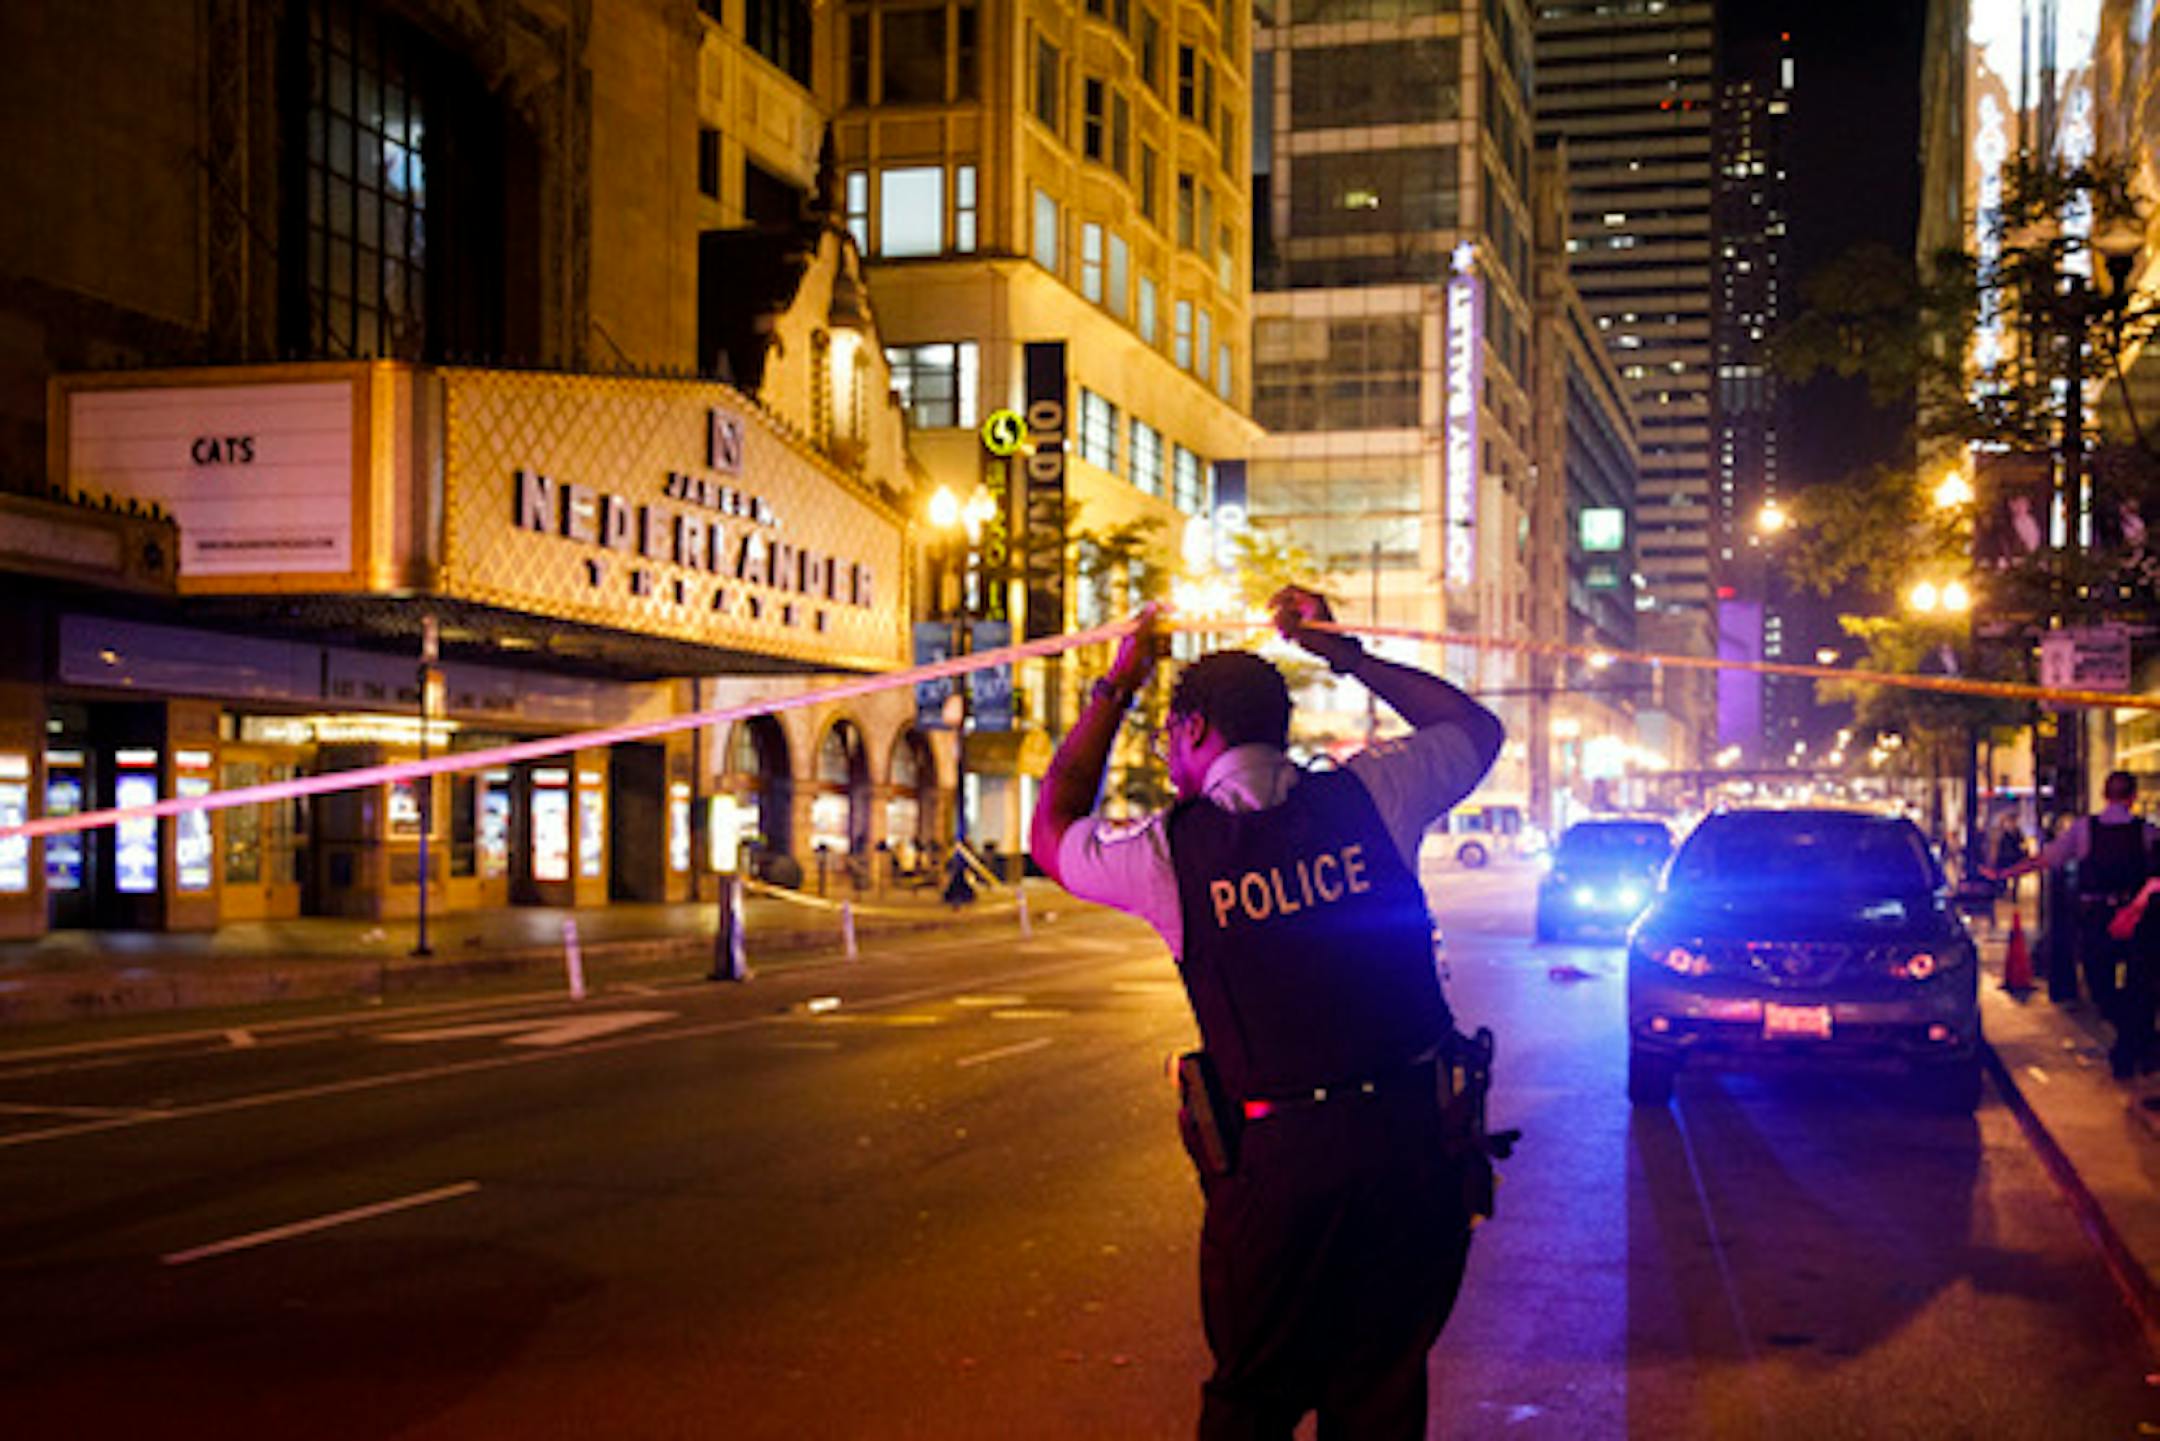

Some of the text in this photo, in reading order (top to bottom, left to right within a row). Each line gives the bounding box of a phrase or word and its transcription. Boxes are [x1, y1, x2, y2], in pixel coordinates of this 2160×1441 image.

[1448, 284, 1472, 417] BALLET
[191, 437, 255, 465] CATS
[1028, 400, 1062, 597] OLD NAVY
[514, 469, 873, 608] NEDERLANDER
[1210, 845, 1370, 928] POLICE
